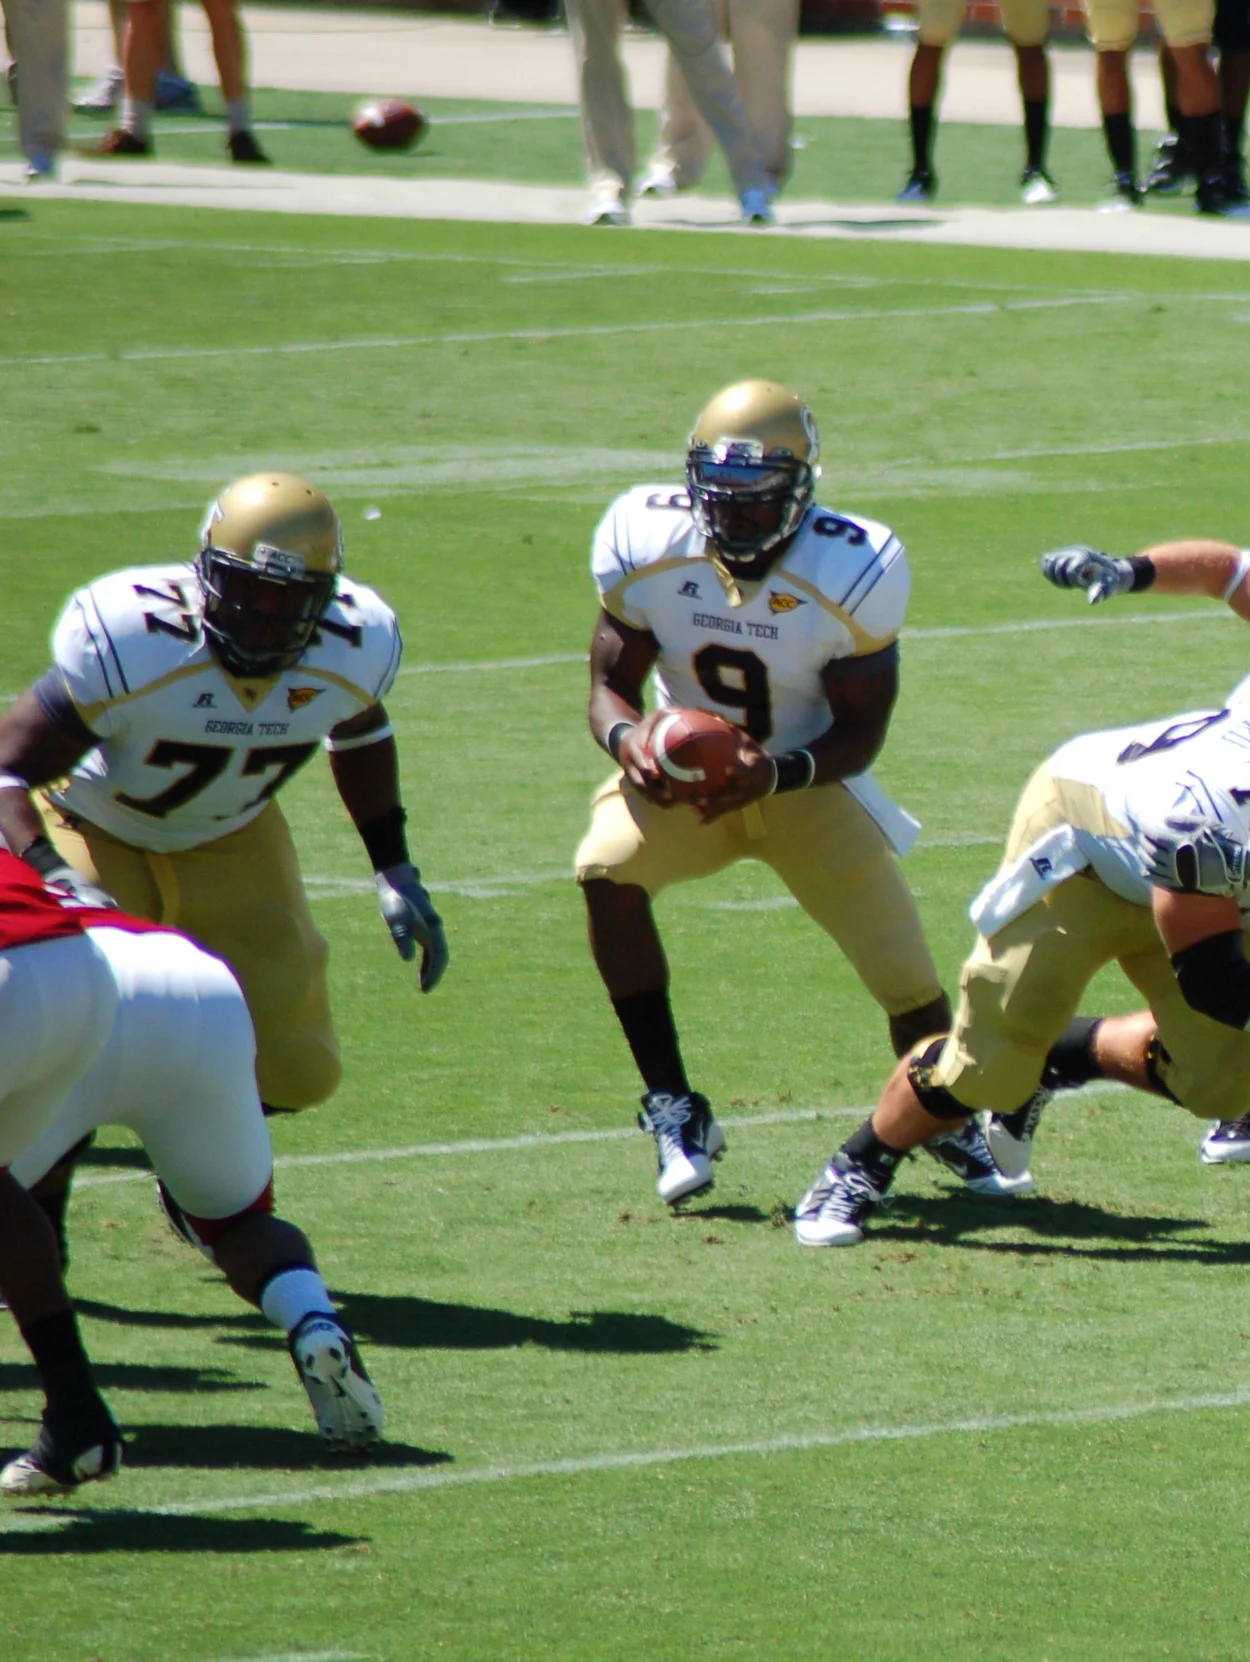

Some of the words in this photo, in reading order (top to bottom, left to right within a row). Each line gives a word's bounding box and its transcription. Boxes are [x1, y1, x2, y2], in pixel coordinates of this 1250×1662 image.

[692, 612, 743, 635] GEORGIA
[747, 622, 779, 640] TECH
[691, 641, 774, 746] 9
[204, 719, 254, 736] GEORGIA
[258, 722, 291, 737] TECH
[113, 738, 321, 821] 77
